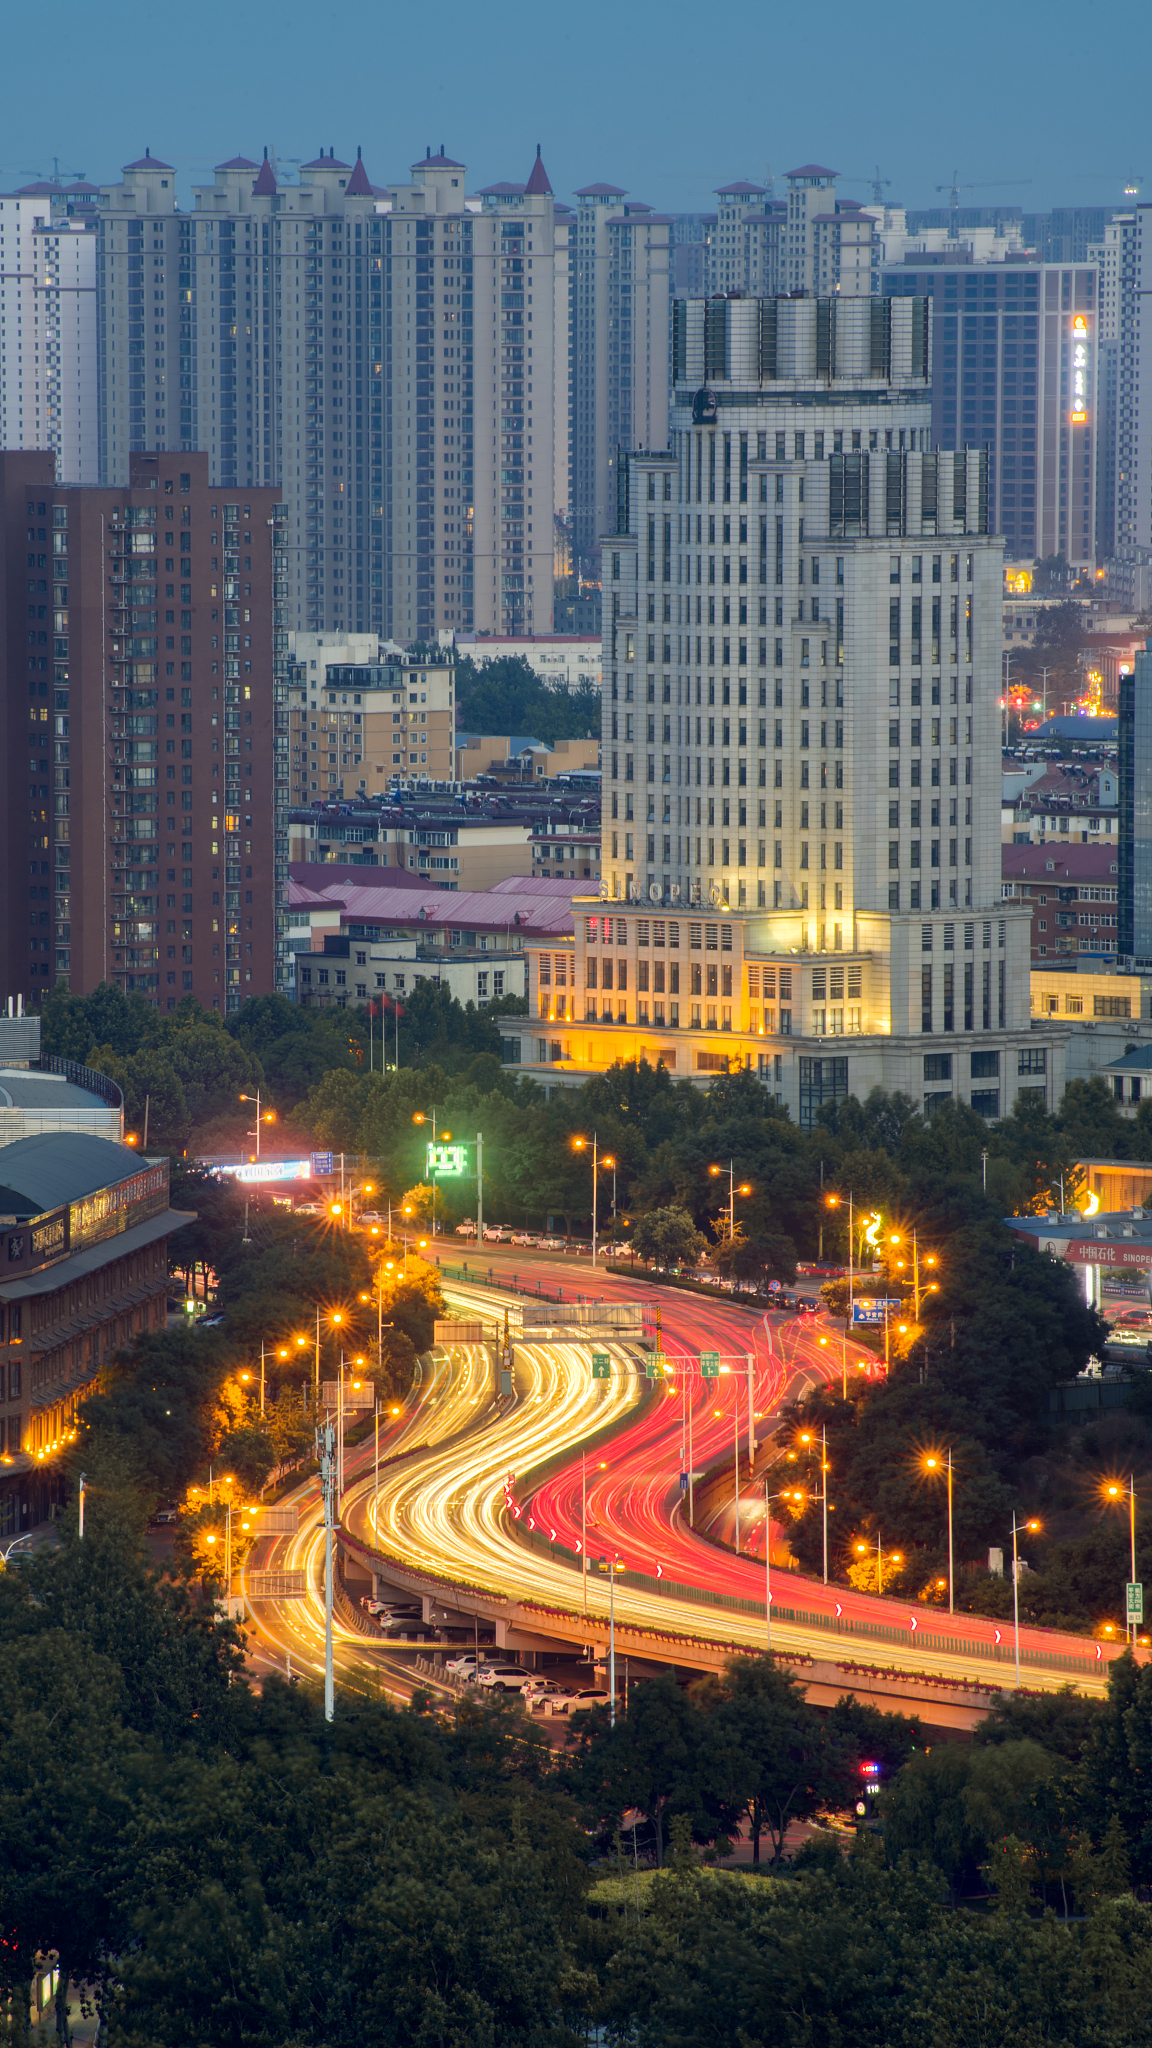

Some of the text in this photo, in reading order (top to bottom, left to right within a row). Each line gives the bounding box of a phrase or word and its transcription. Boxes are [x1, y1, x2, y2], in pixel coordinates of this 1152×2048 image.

[598, 879, 721, 905] SINOPEC
[1079, 1245, 1116, 1261] 中国石化
[593, 1357, 609, 1365] 东二环
[866, 1785, 879, 1794] 110
